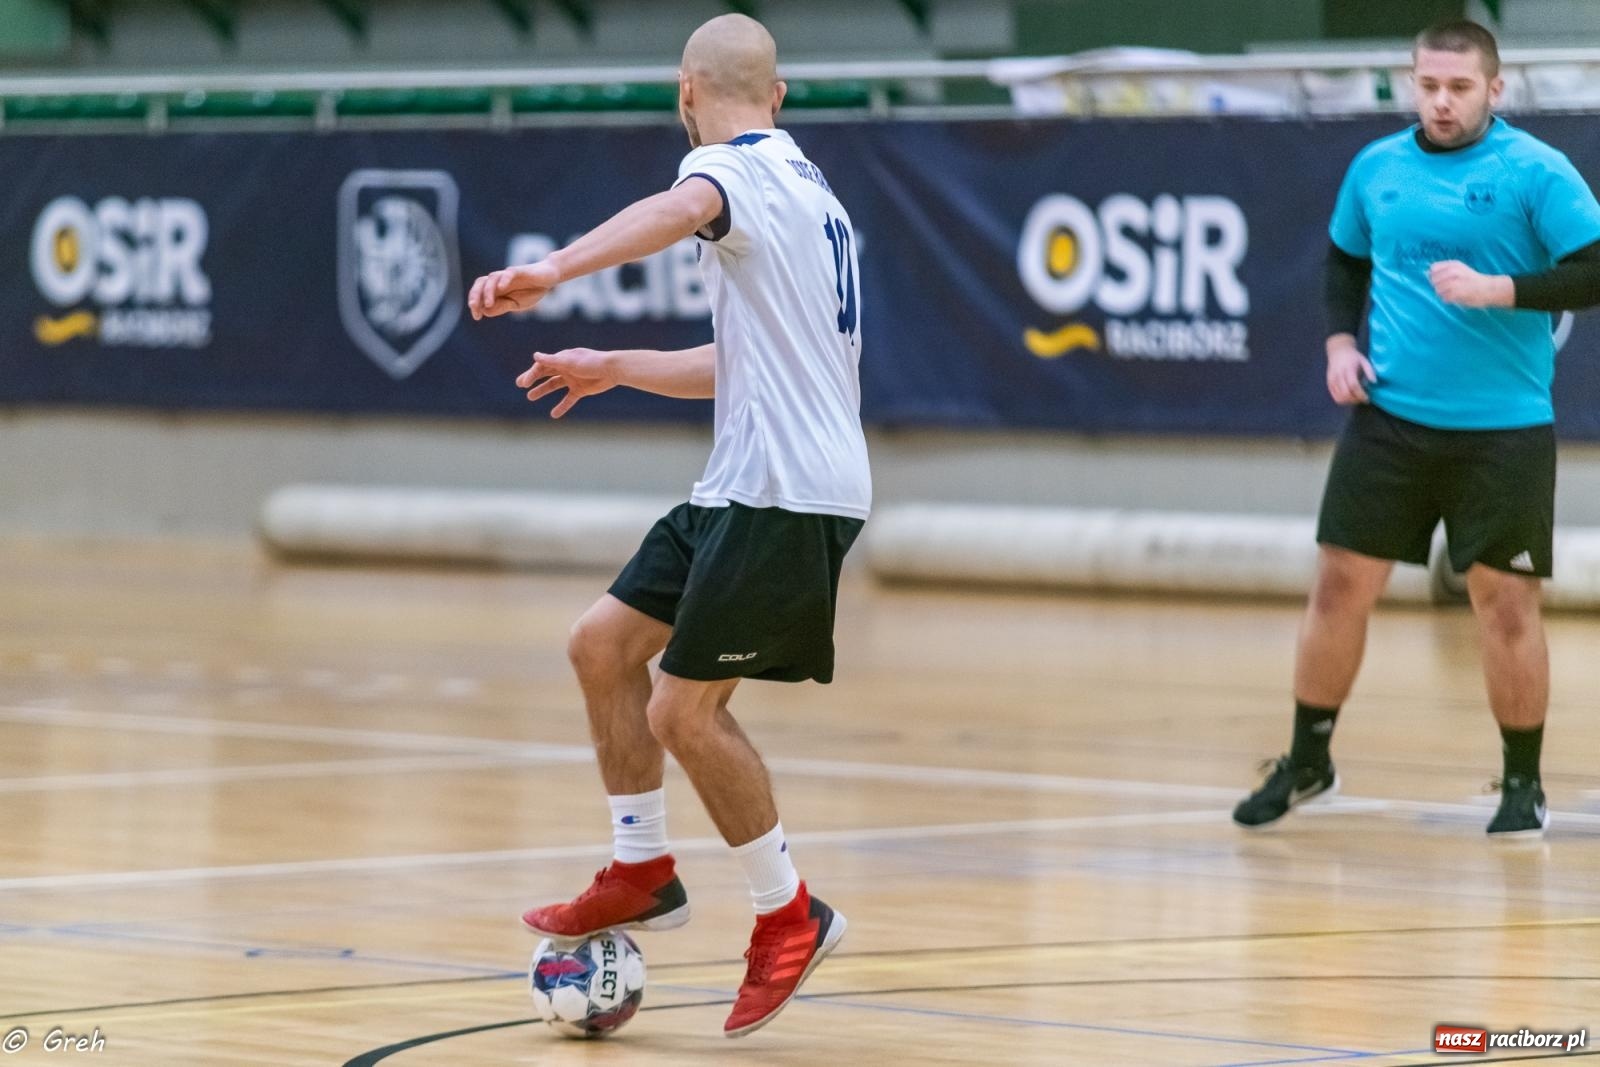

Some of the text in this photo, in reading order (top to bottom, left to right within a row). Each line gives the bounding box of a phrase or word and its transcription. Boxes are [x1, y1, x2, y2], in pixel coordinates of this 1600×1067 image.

[31, 197, 212, 305] OSiR
[824, 211, 857, 346] 10
[1017, 193, 1250, 316] OSiR
[600, 939, 618, 1001] SELECT
